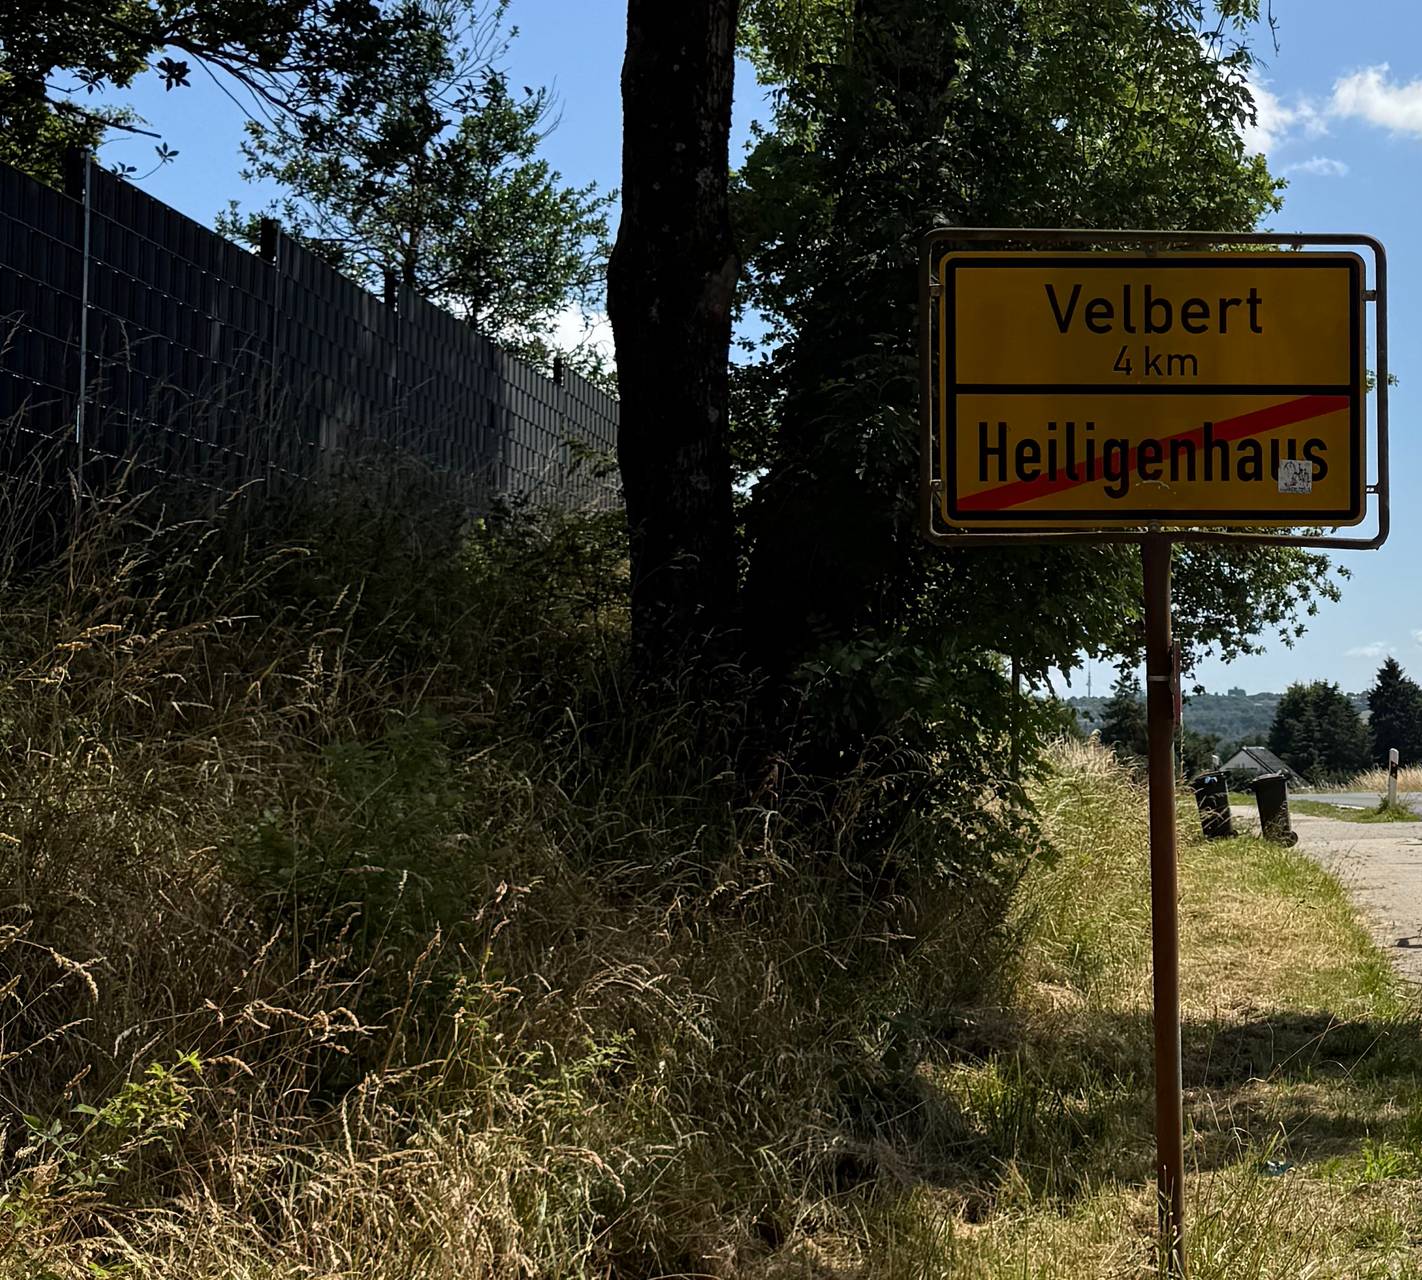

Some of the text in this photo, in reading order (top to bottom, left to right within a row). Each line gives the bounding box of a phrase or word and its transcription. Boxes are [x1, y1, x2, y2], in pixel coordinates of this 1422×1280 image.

[1044, 283, 1263, 335] Velbert
[1112, 345, 1199, 377] 4 km
[978, 421, 1329, 499] Heiligenhaus
